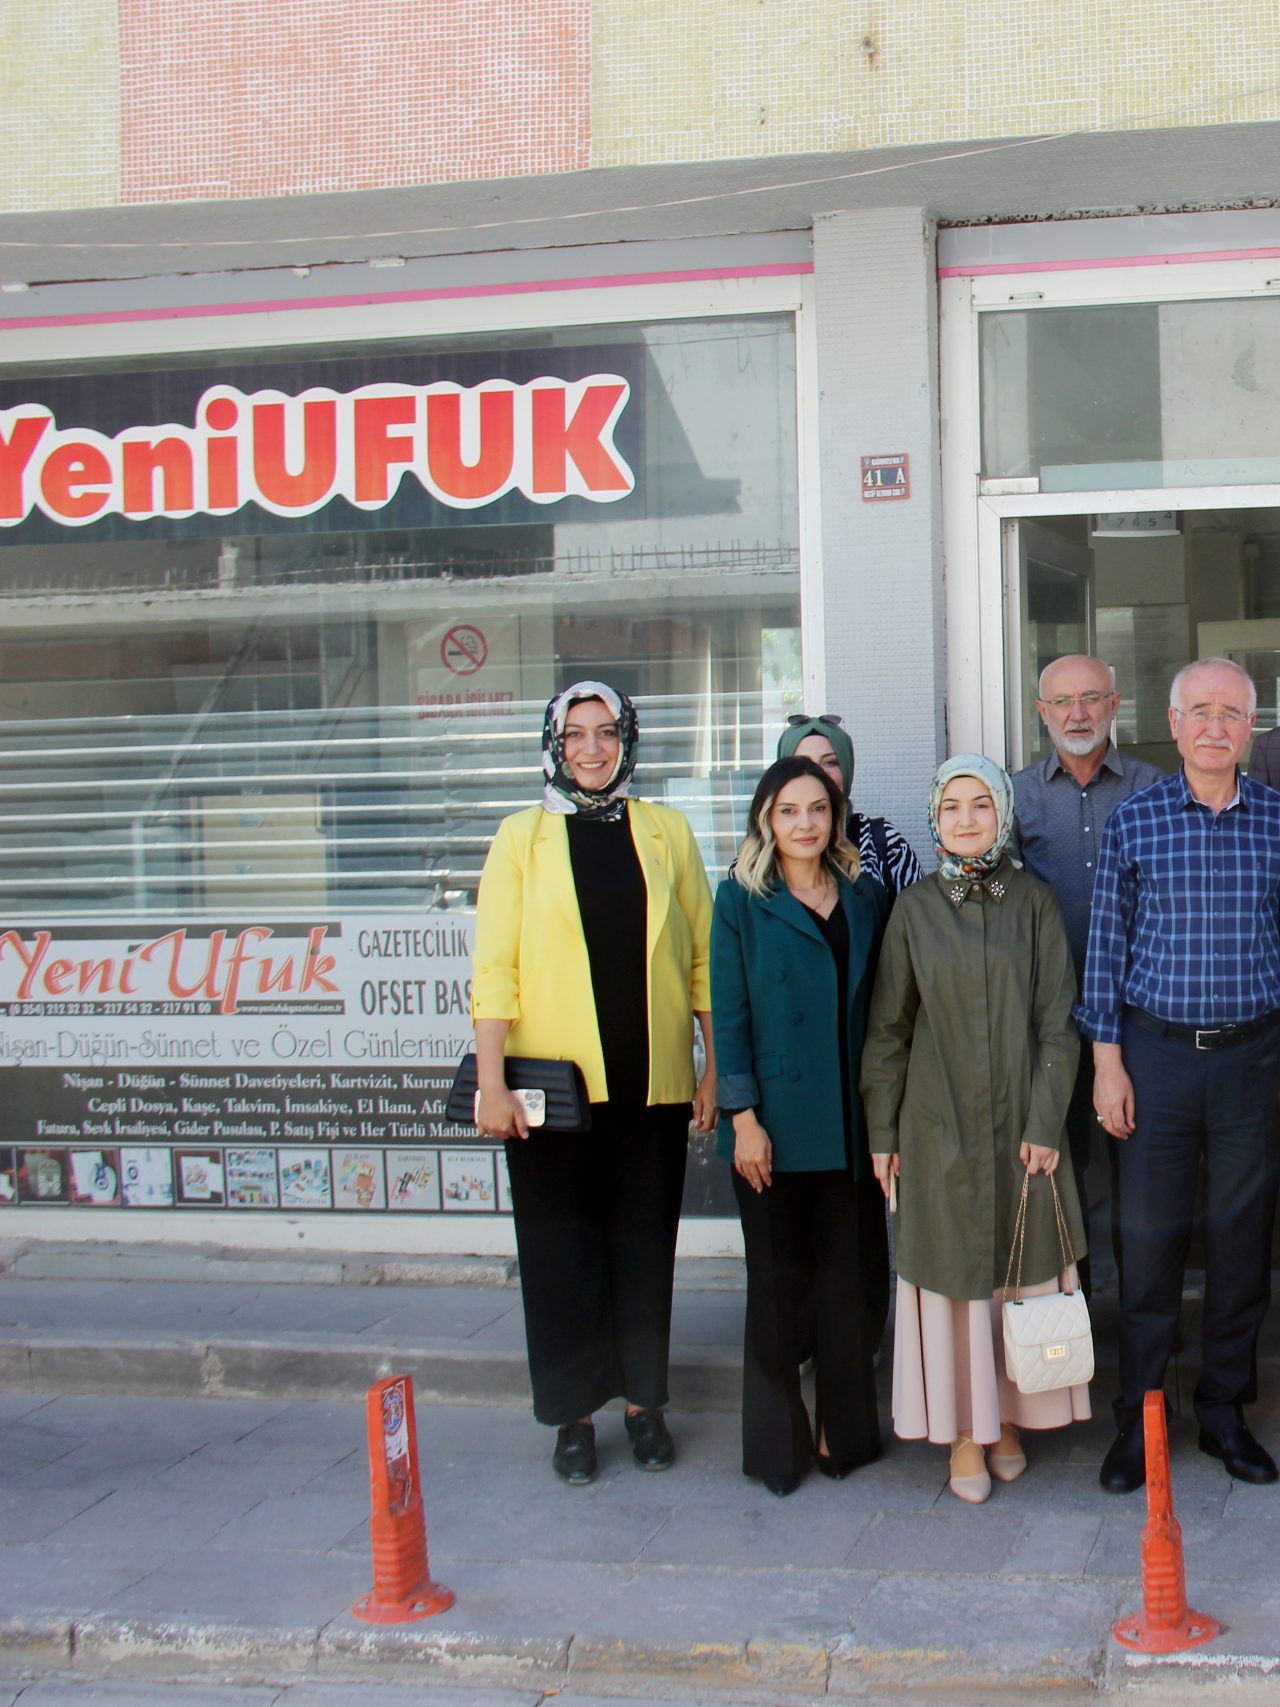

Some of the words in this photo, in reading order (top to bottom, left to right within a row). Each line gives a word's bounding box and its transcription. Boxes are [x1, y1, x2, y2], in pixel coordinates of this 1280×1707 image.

[863, 469, 884, 487] 41
[895, 467, 906, 484] A
[358, 921, 470, 958] GAZETECİLİK
[0, 929, 144, 1000] Yeni
[139, 925, 342, 1016] Ufuk
[46, 1002, 66, 1015] 212
[66, 1002, 80, 1015] 32
[81, 1002, 96, 1015] 32
[104, 1002, 122, 1015] 217
[124, 1002, 138, 1015] 54
[138, 1002, 153, 1015] 32
[162, 1002, 180, 1015] 217
[360, 979, 427, 1016] OFSET
[232, 1038, 261, 1059] ve
[271, 1023, 333, 1059] Özel
[63, 1072, 105, 1092] Nişan
[117, 1072, 166, 1091] Düğün
[179, 1072, 231, 1090] Sünnet
[235, 1072, 327, 1092] Davetiyeleri,
[330, 1072, 398, 1091] Kartvizit,
[87, 1098, 127, 1116] Cepli
[130, 1098, 179, 1115] Dosya,
[181, 1098, 221, 1117] Kaşe,
[223, 1098, 281, 1115] Takvim,
[285, 1095, 353, 1116] İmsakiye,
[357, 1098, 374, 1114] El
[378, 1095, 417, 1116] İlanı,
[36, 1119, 81, 1136] Fatura,
[82, 1119, 113, 1136] Sevk
[115, 1117, 172, 1138] İrsaliyesi,
[174, 1120, 211, 1137] Gider
[213, 1120, 267, 1138] Pusulası,
[269, 1120, 281, 1136] P.
[283, 1120, 315, 1140] Satış
[317, 1121, 340, 1140] Fişi
[343, 1125, 357, 1137] ve
[361, 1122, 386, 1137] Her
[389, 1121, 426, 1137] Türlü
